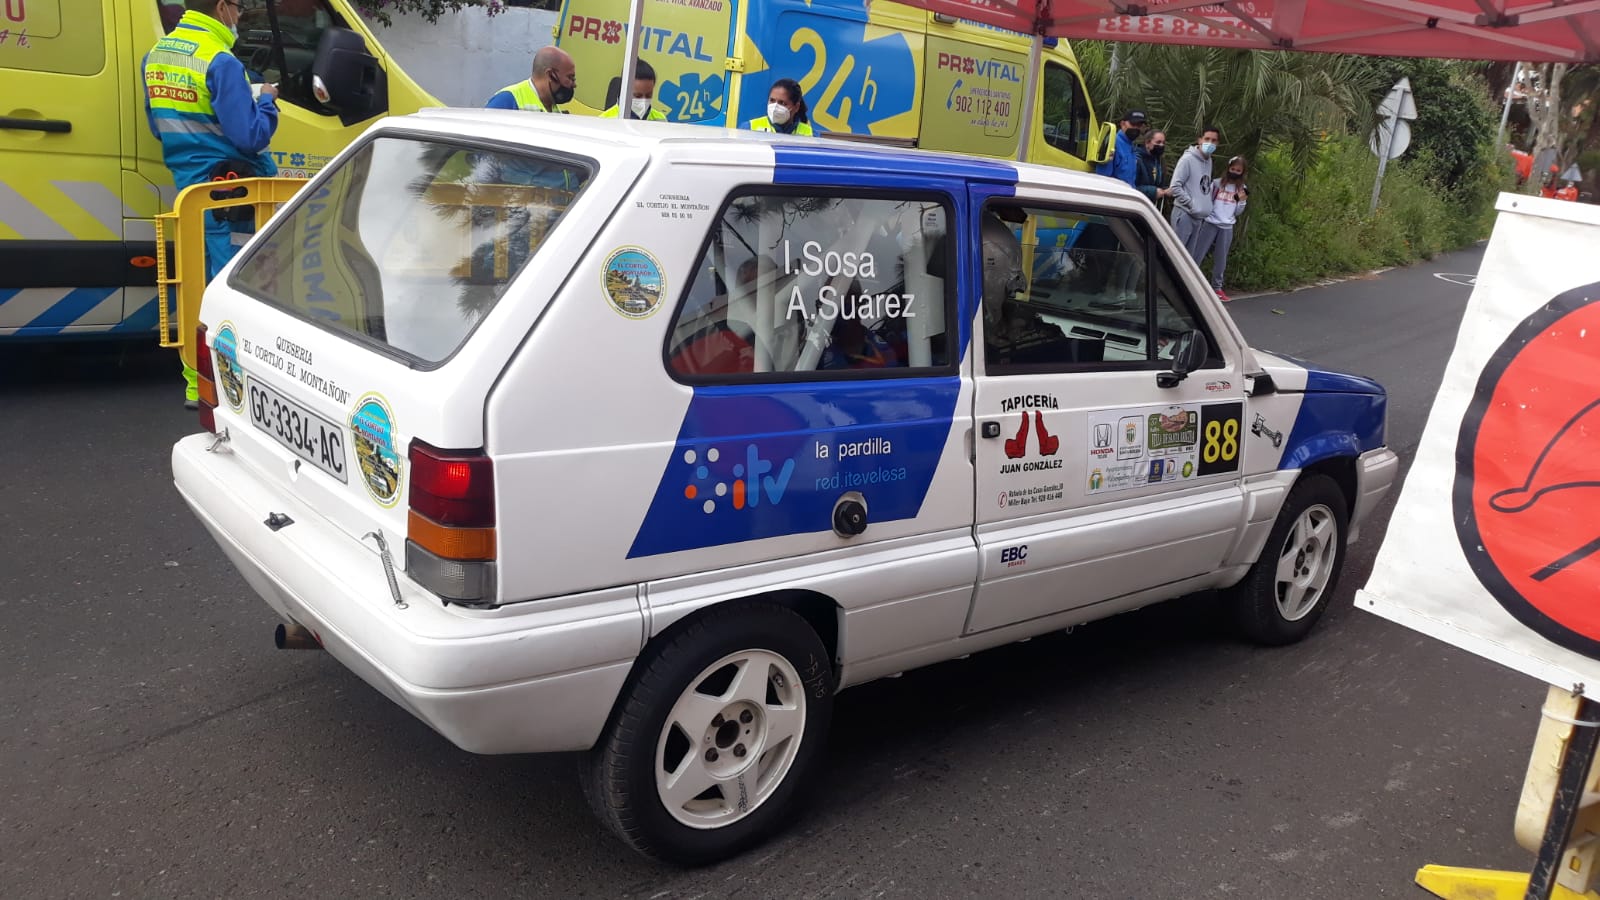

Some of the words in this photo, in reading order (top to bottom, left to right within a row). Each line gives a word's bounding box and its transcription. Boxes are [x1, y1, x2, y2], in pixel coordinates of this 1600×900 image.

[177, 90, 195, 101] 400
[956, 96, 973, 112] 902
[976, 98, 992, 117] 112
[994, 101, 1010, 118] 400
[784, 239, 875, 279] I.Sosa
[785, 285, 917, 321] A.Suárez
[254, 345, 284, 371] CORTIJO
[286, 361, 297, 378] EL
[275, 336, 312, 366] QUESERIA
[1001, 393, 1059, 413] TAPICERÍA
[816, 441, 829, 458] la
[839, 437, 891, 461] pardilla
[1090, 447, 1114, 456] HONDA
[1203, 418, 1239, 464] 88
[816, 466, 907, 491] red.itevelesa
[1000, 463, 1021, 474] JUAN
[1000, 545, 1028, 563] EBC
